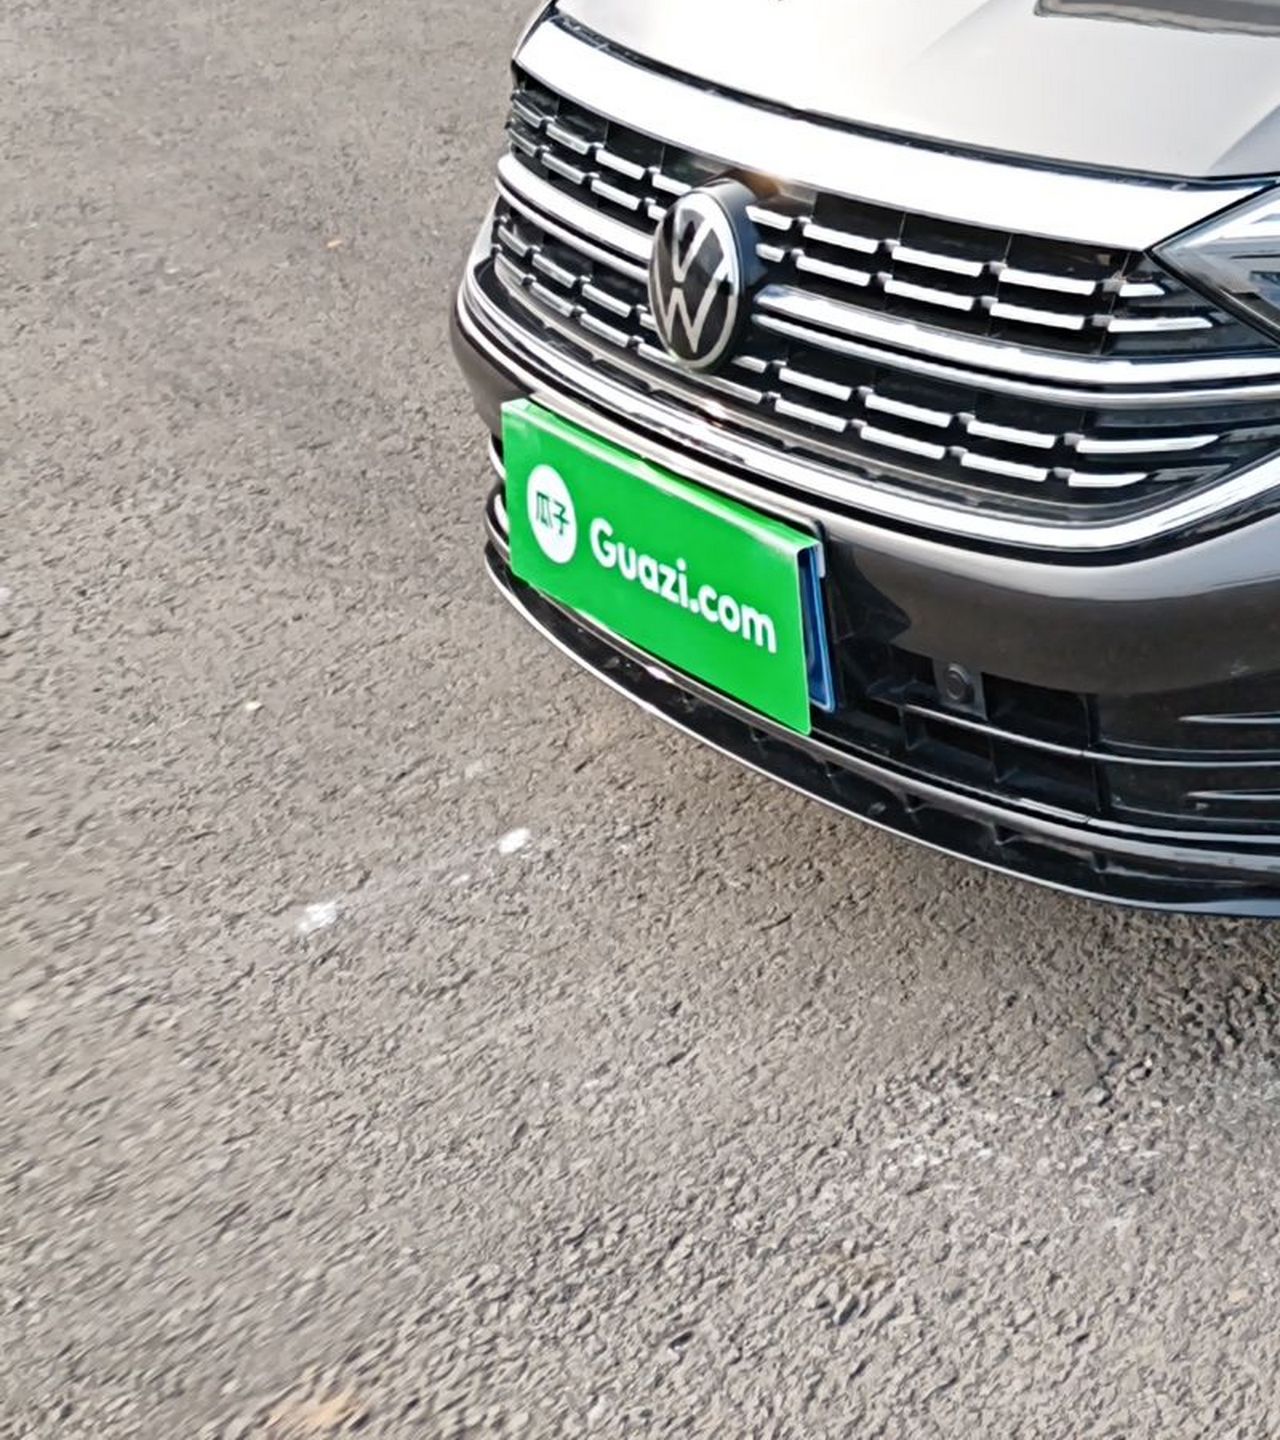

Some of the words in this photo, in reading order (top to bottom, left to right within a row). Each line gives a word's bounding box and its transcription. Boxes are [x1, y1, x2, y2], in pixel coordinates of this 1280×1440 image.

[650, 188, 740, 371] VW
[535, 491, 570, 536] 瓜子
[590, 517, 777, 654] Guazi.com
